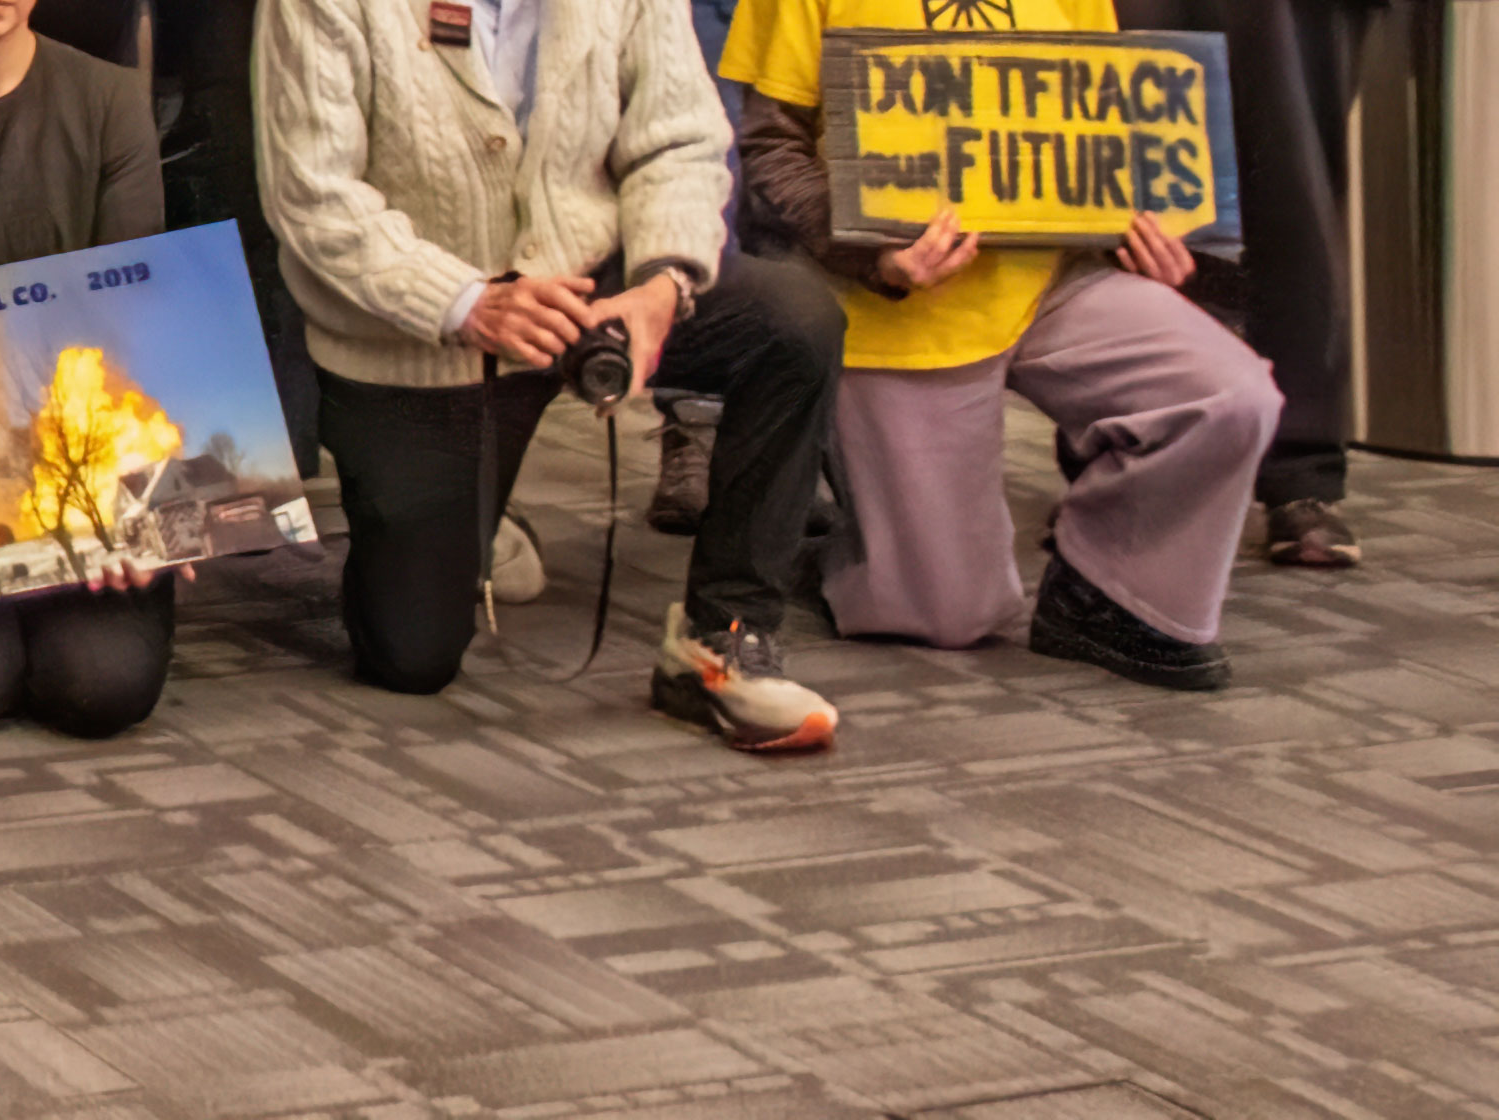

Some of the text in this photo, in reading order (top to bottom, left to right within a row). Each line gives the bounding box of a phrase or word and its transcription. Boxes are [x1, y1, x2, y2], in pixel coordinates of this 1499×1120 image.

[947, 126, 1204, 212] FUTURES
[12, 282, 57, 307] CO.
[86, 262, 150, 291] 2019
